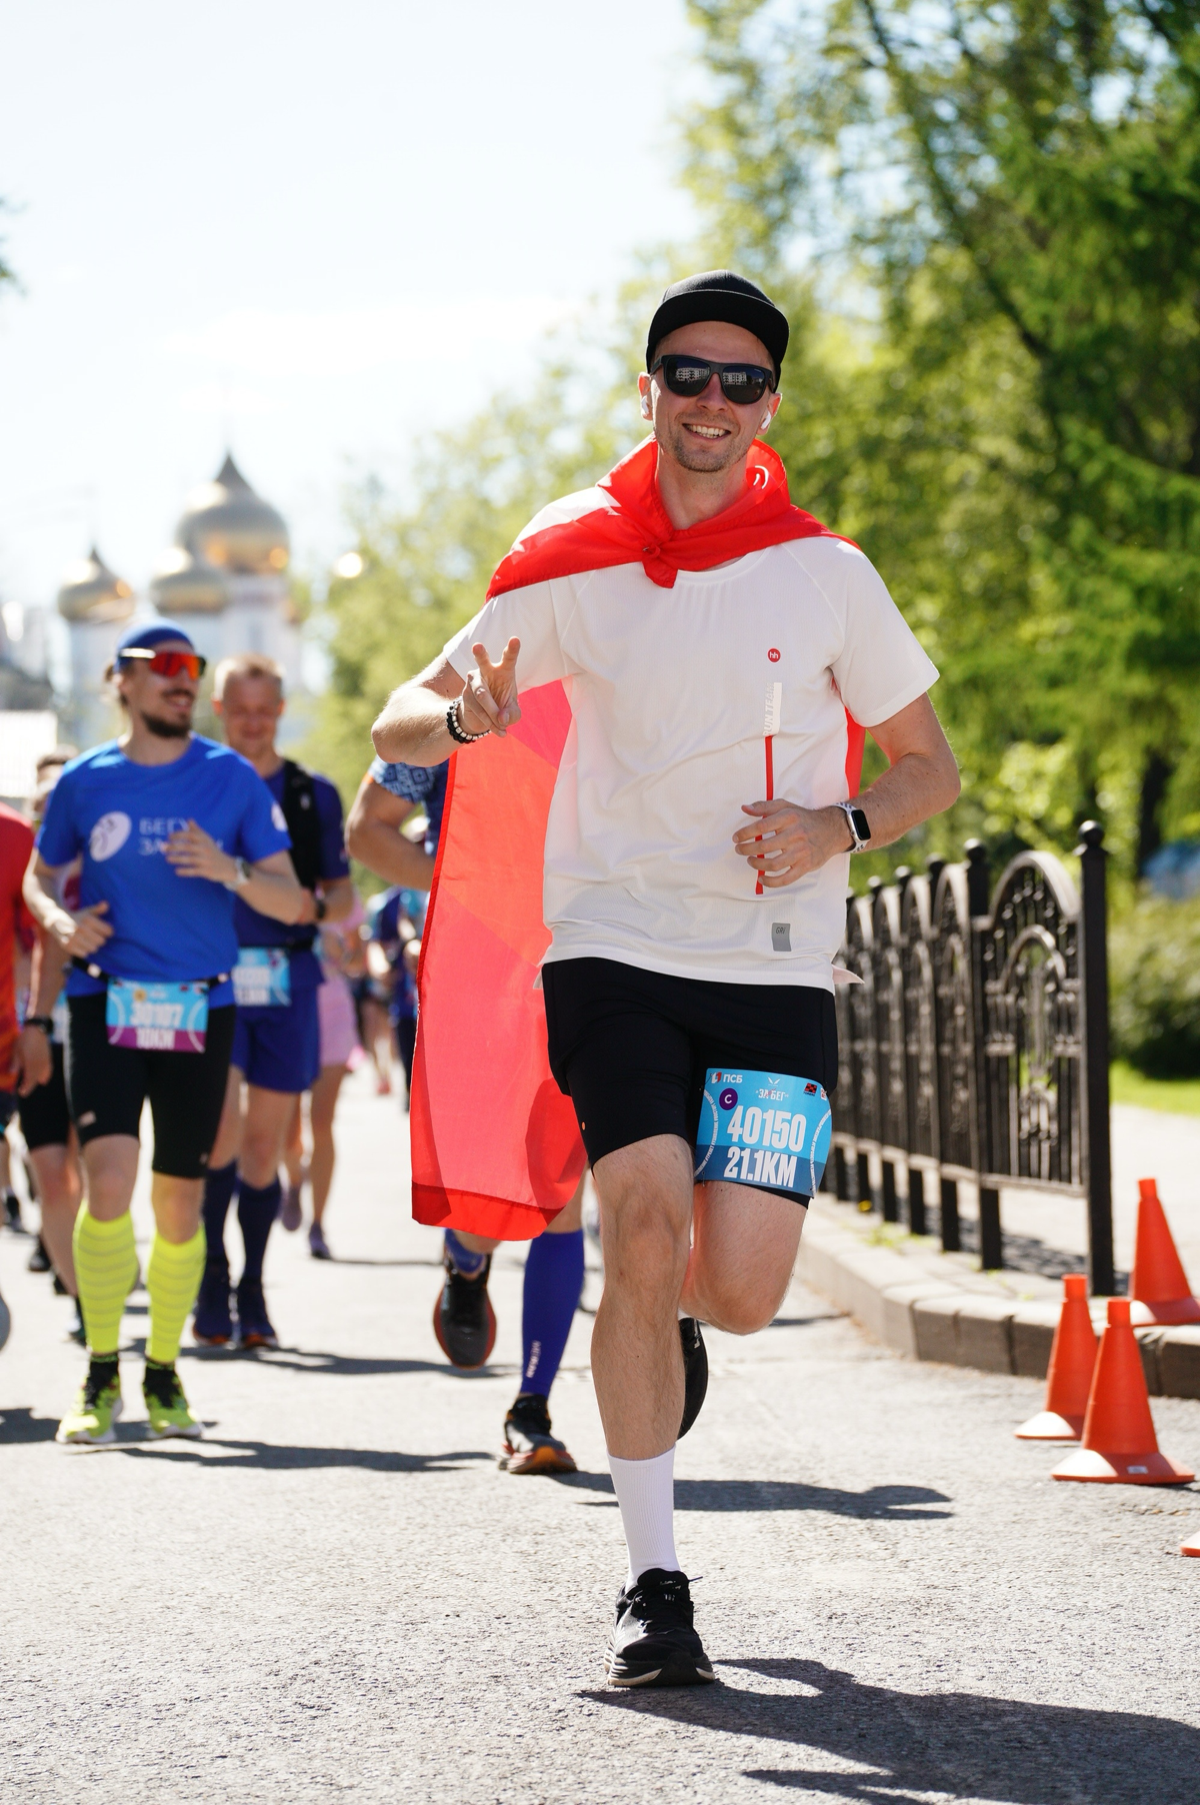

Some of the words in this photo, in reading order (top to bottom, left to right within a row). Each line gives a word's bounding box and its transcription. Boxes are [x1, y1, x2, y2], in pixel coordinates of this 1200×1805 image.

[762, 713, 774, 737] RUN
[722, 1073, 743, 1084] ПСБ
[727, 1105, 807, 1153] 40150
